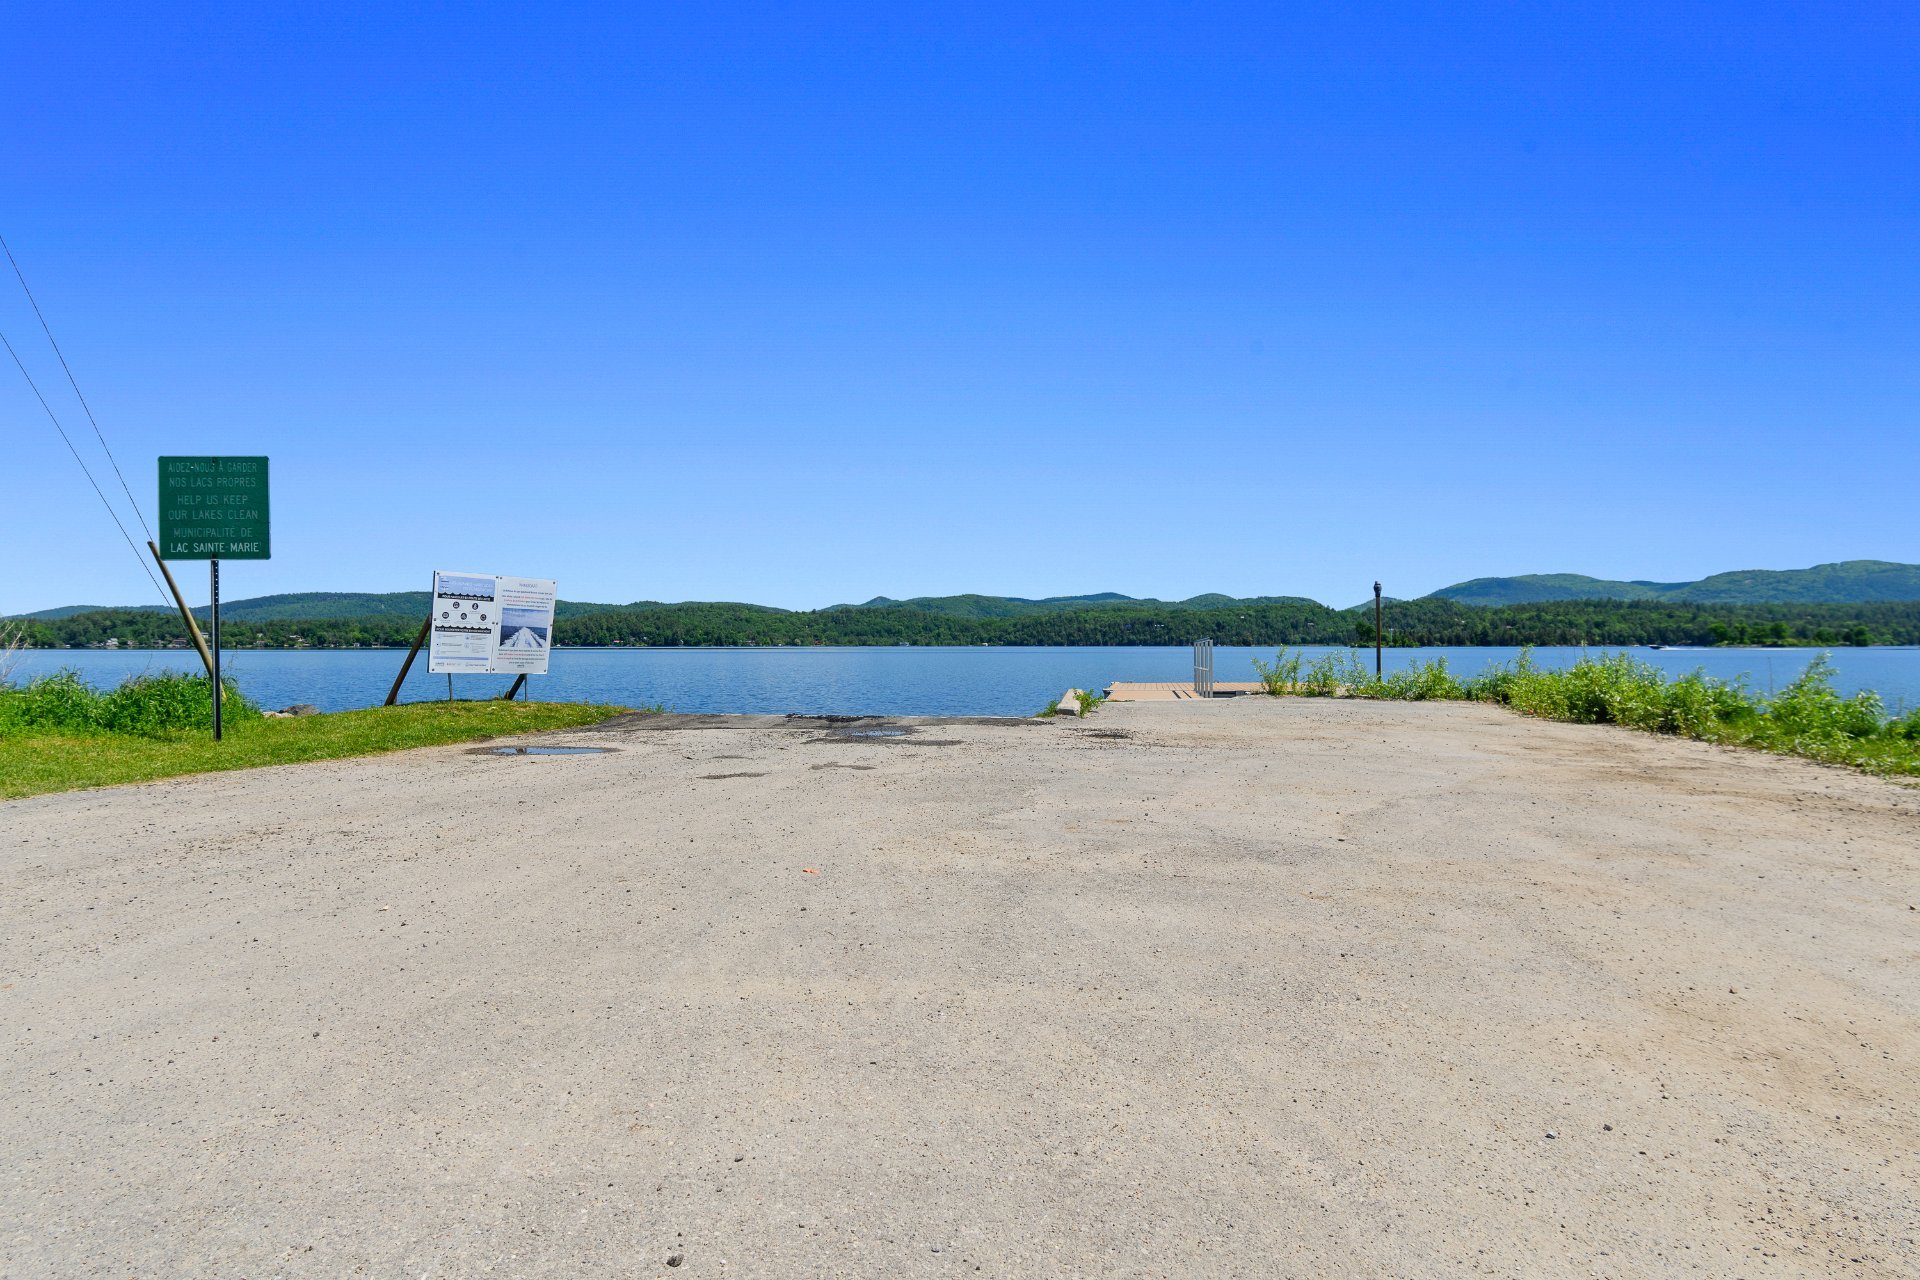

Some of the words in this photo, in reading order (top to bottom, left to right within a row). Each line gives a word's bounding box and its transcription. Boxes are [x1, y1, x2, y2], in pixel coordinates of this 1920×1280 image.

[168, 462, 215, 473] AIDEZ-NOUS
[227, 462, 257, 473] GARDER
[169, 477, 187, 488] NOS
[191, 477, 213, 488] LACS
[217, 477, 257, 488] PROPRES
[177, 495, 202, 505] HELP
[206, 495, 218, 505] US
[223, 495, 249, 505] KEEP
[168, 510, 188, 520] OUR
[192, 510, 223, 520] LAKES
[227, 510, 259, 520] CLEAN
[173, 526, 236, 538] MUNICIPALITÉ
[240, 528, 253, 538] DE
[170, 542, 189, 553] LAC
